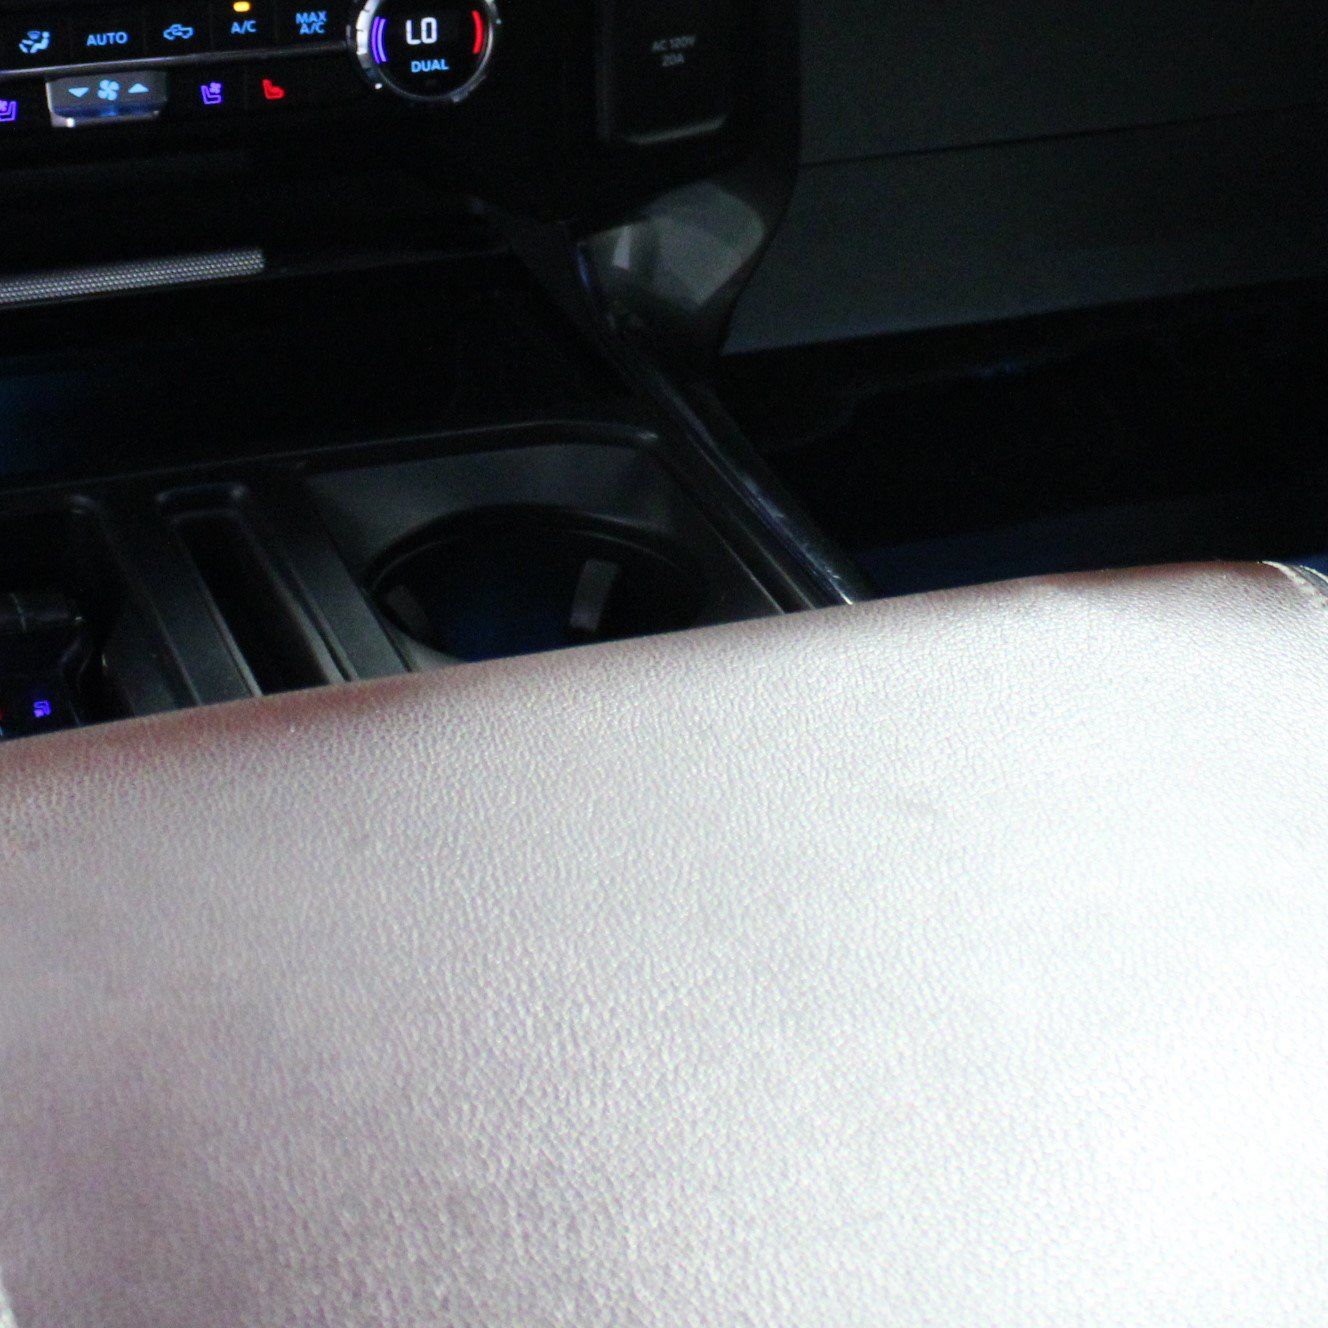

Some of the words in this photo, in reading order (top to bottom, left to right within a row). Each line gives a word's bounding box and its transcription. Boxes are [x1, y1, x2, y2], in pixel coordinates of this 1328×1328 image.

[295, 10, 327, 24] MAX
[230, 20, 256, 34] A/C
[299, 22, 325, 35] A/C
[405, 17, 438, 46] LO
[86, 31, 129, 47] AUTO
[410, 58, 449, 73] DUAL
